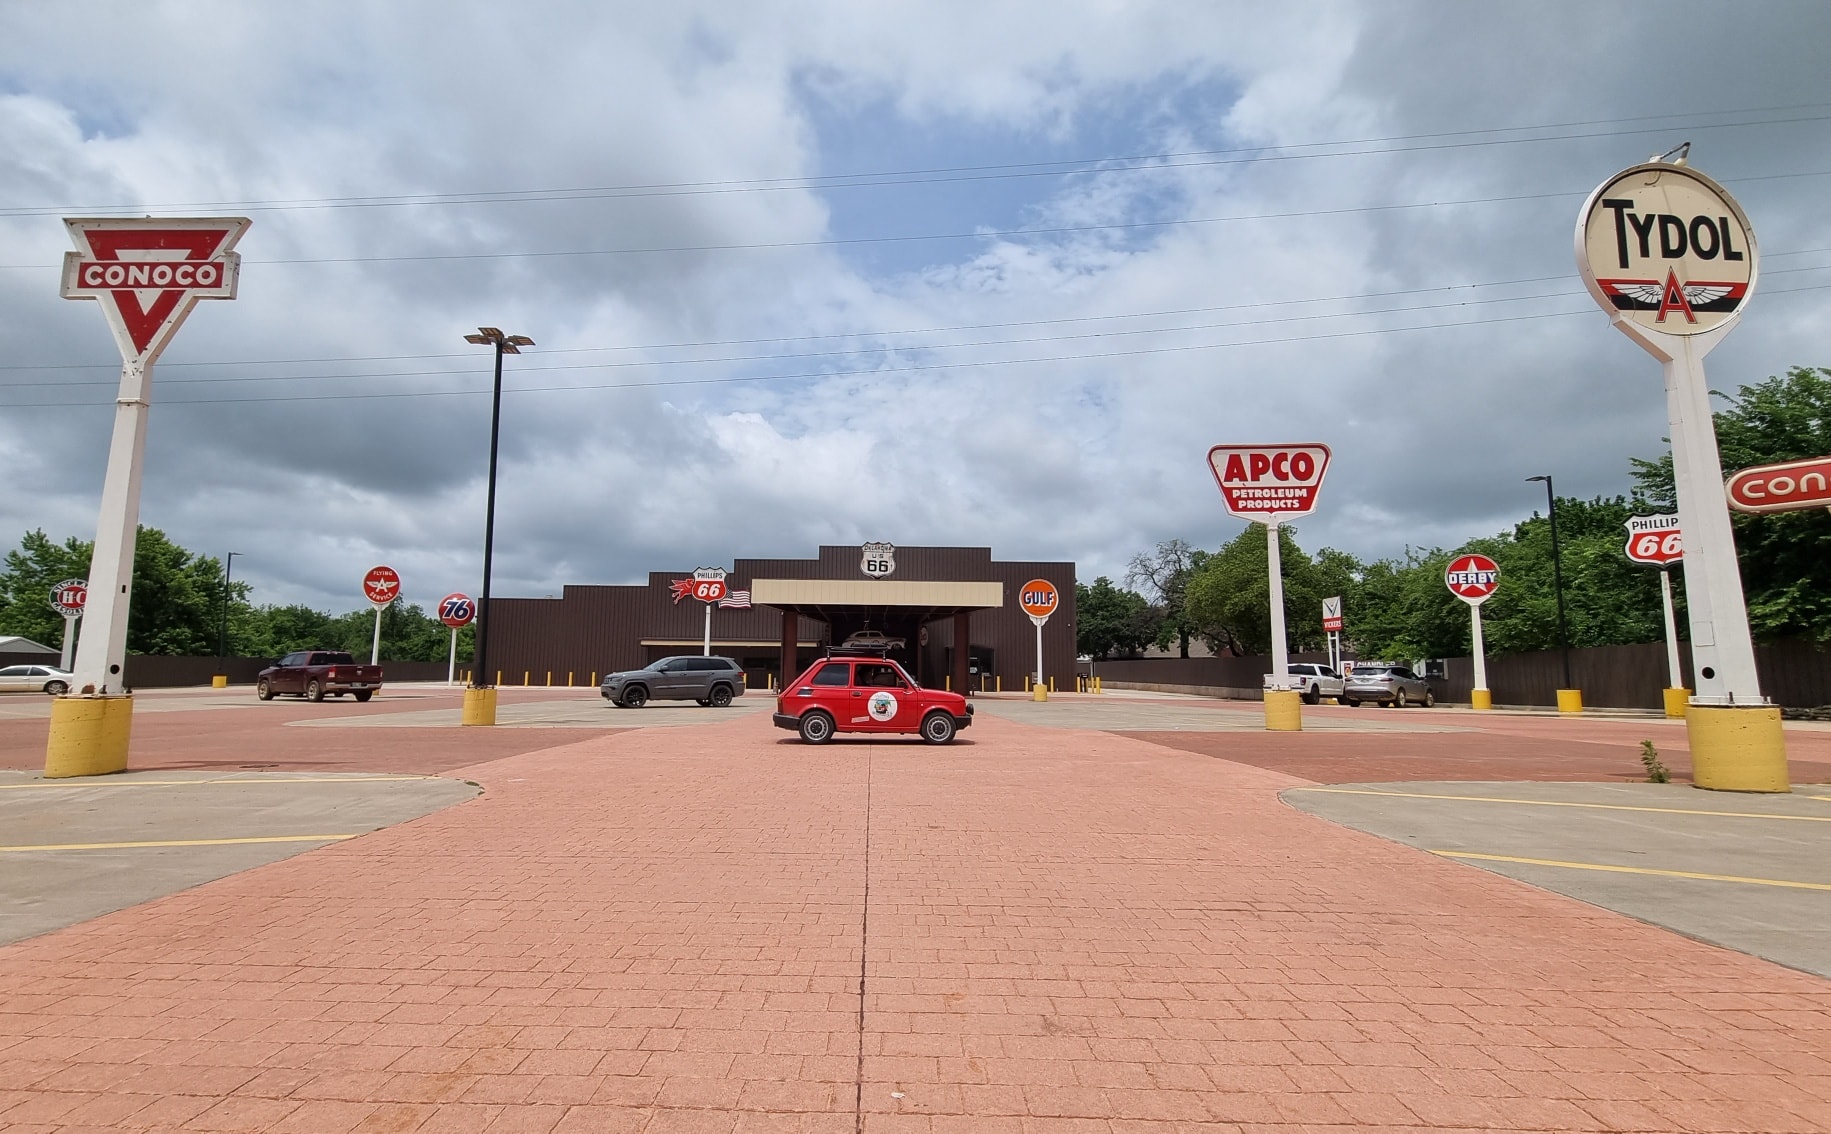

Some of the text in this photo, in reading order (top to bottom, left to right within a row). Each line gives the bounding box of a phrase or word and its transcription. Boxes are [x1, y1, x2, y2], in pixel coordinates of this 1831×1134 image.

[1602, 199, 1743, 269] TYDOL
[84, 265, 217, 286] CONOCO
[1223, 452, 1315, 483] APCO
[1742, 472, 1831, 499] con
[1232, 488, 1308, 499] PETROLEUM
[1238, 499, 1300, 509] PRODUCTS
[1632, 517, 1679, 531] PHILLIP
[1636, 533, 1682, 557] 66
[867, 560, 889, 573] 66
[1448, 572, 1497, 585] DERBY
[53, 580, 88, 593] SINCLA
[697, 583, 721, 598] 66
[369, 591, 393, 601] SERVICE
[1023, 590, 1055, 607] GULF
[52, 601, 85, 615] GASOLI
[442, 598, 471, 621] 76
[1323, 620, 1342, 629] VICKERS
